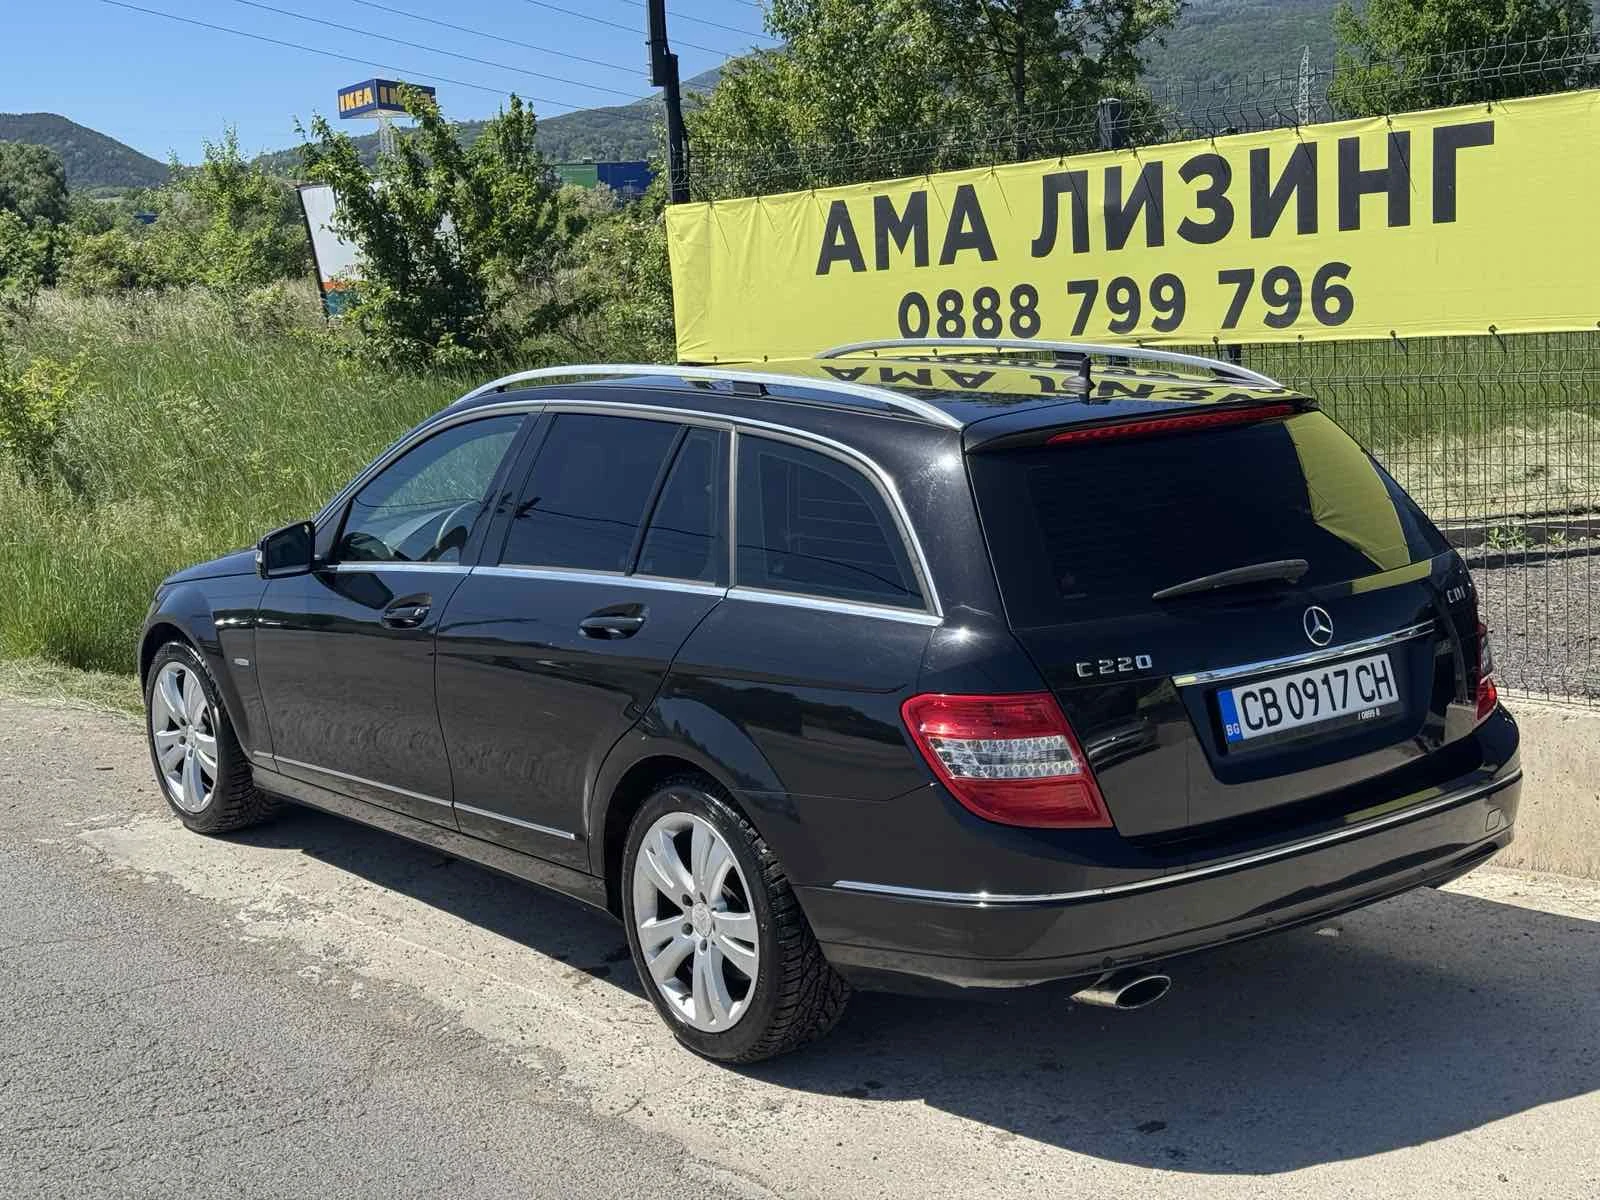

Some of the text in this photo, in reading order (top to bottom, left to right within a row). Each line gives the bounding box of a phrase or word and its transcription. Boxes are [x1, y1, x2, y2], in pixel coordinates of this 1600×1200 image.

[340, 87, 374, 112] IKEA
[815, 120, 1495, 276] АМА ЛИЗИНГ
[898, 262, 1355, 339] 0888 799 796
[1076, 655, 1152, 677] C 220
[1240, 660, 1393, 731] CB 0917 CH
[1226, 722, 1241, 737] BG
